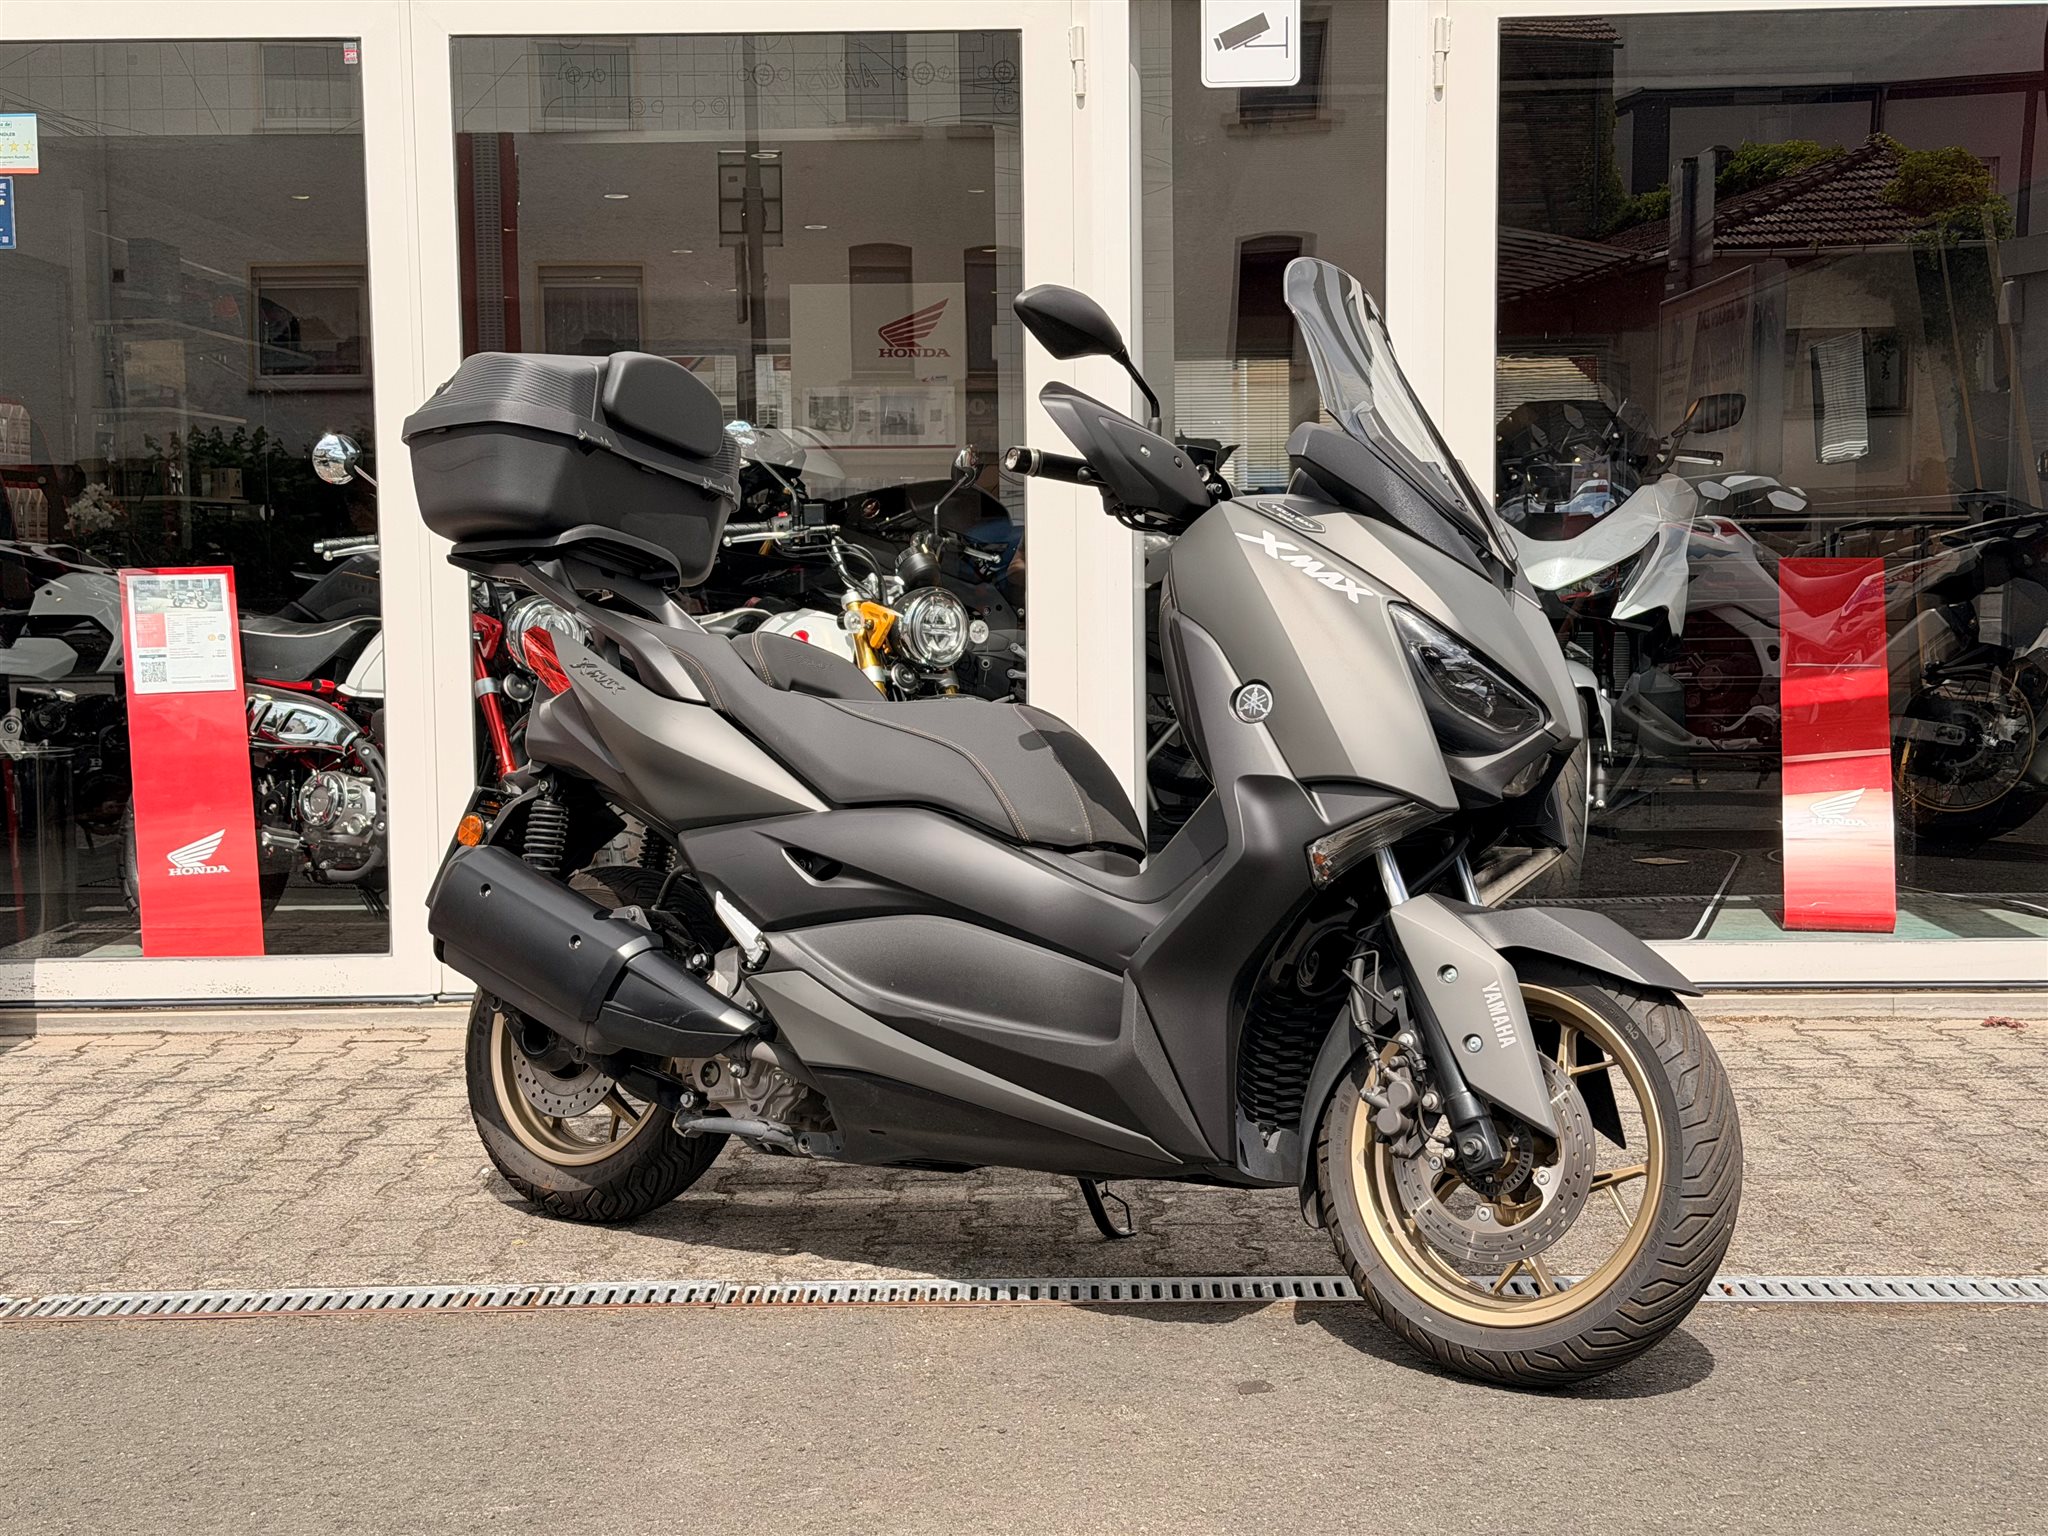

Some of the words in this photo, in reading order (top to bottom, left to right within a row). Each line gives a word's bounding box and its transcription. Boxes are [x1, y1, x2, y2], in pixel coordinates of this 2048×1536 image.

[878, 348, 951, 358] HONDA
[1810, 817, 1869, 827] HONDA
[168, 864, 231, 876] HONDA
[1482, 980, 1517, 1049] YAMAHA
